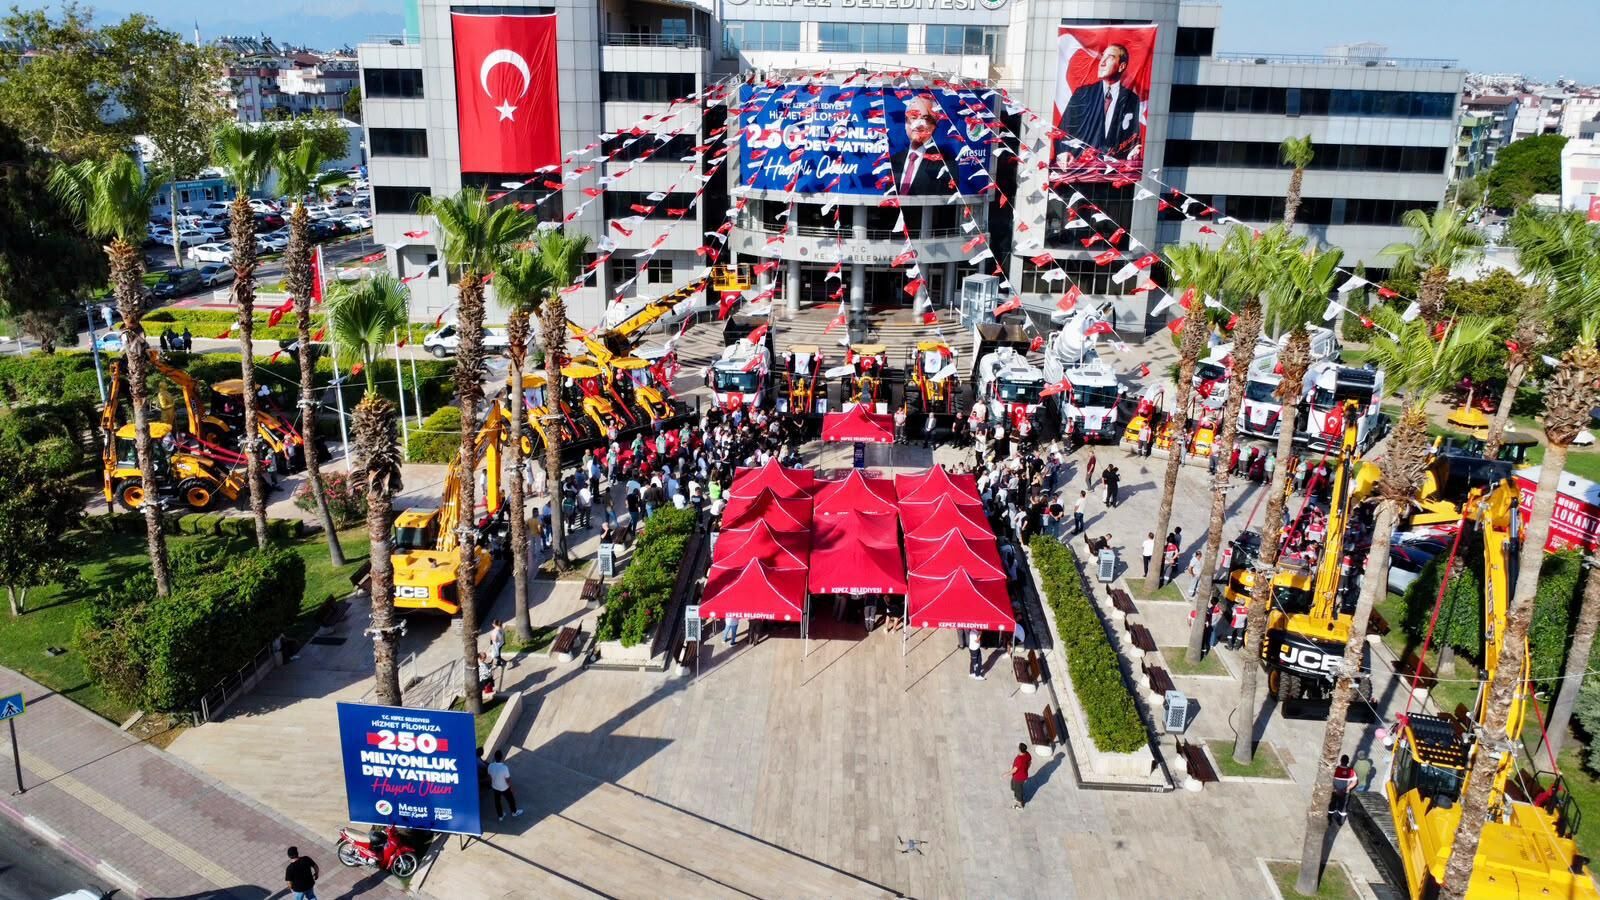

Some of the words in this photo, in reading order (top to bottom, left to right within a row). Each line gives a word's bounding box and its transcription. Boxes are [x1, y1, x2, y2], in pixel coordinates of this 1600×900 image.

[804, 140, 831, 151] DEV
[394, 586, 429, 598] JCB
[371, 719, 399, 729] HİZMET
[401, 722, 441, 732] FİLOMUZA
[377, 729, 438, 754] 250
[362, 764, 394, 778] DEV
[396, 768, 459, 784] YATIRIM
[418, 781, 453, 797] Olsun
[398, 803, 428, 813] Mesut
